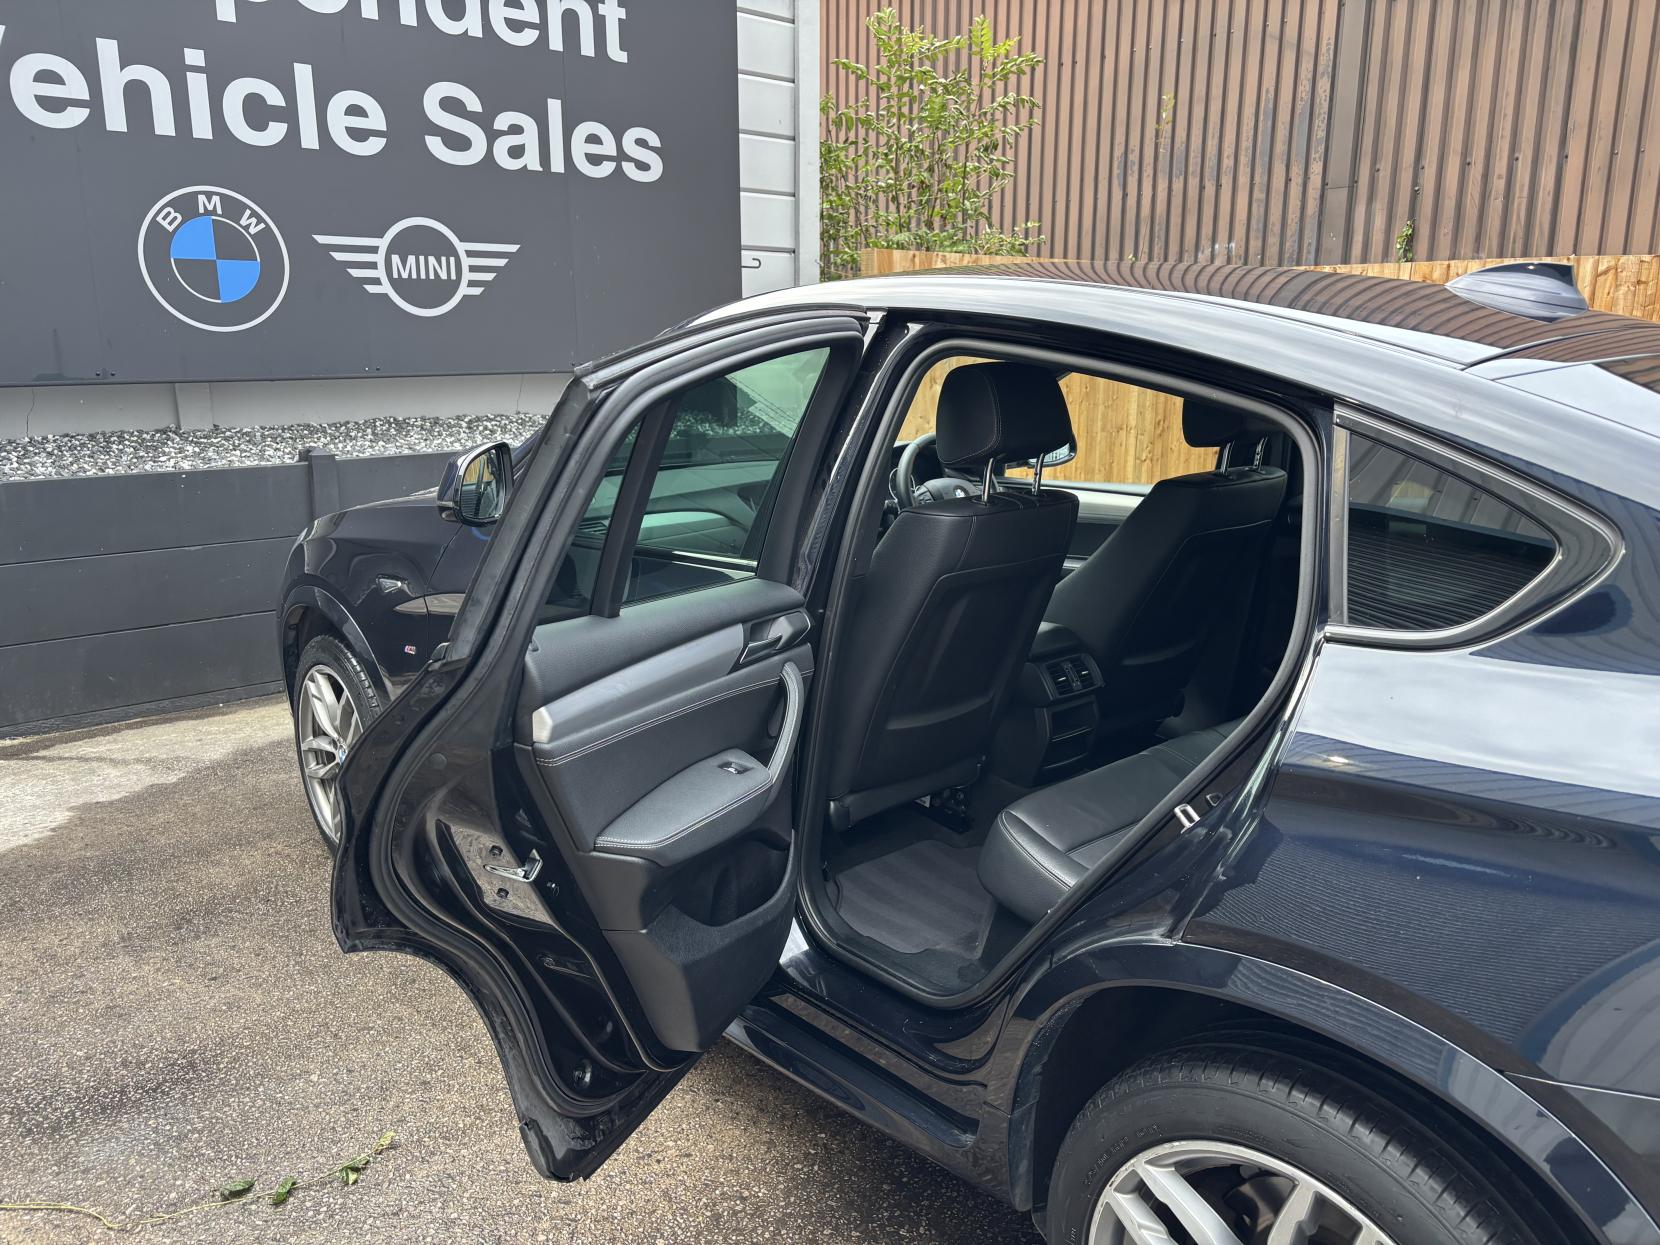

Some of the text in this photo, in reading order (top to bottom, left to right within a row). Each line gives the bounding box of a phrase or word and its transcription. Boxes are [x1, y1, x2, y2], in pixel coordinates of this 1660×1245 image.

[0, 24, 664, 183] ehicle Sales
[155, 194, 266, 236] BMW
[390, 254, 457, 281] MINI
